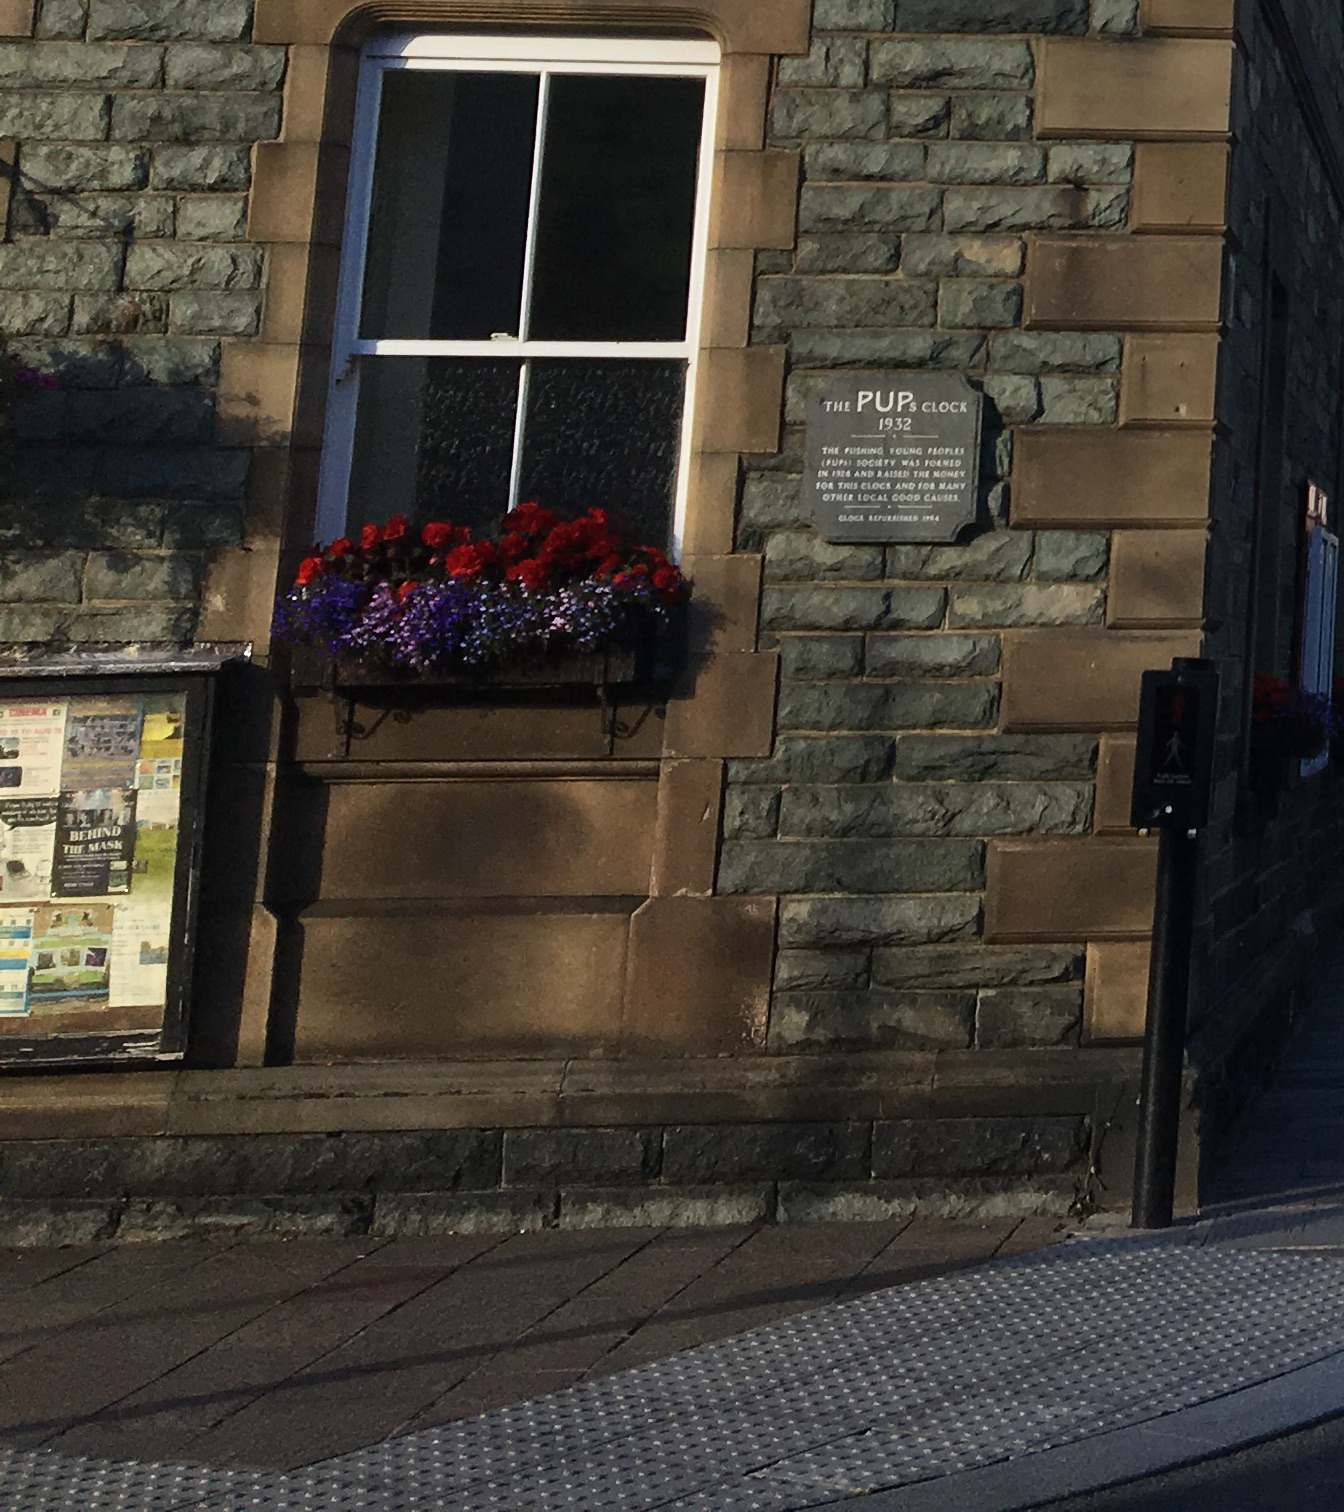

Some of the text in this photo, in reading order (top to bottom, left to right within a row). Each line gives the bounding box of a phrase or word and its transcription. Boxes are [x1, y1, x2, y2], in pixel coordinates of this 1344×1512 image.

[823, 400, 851, 412] THE
[921, 400, 967, 413] CLOCK
[878, 417, 912, 431] 1932
[821, 447, 965, 455] THE PUSHING YOUNG PEOPLES
[856, 459, 896, 467] SOCIETY
[901, 459, 921, 467] WAS
[924, 459, 962, 467] FORMED
[817, 470, 828, 478] IN
[853, 470, 875, 478] AND
[876, 470, 910, 478] RAISED
[913, 470, 930, 478] THE
[932, 470, 966, 478] MONEY
[815, 482, 967, 491] FOR THIS CLOCK AND FOR MANY
[821, 493, 854, 502] OTHER
[857, 493, 888, 502] LOCAL
[891, 493, 921, 502] GOOD
[69, 826, 121, 842] BEHIND
[62, 840, 123, 854] THE MASK
